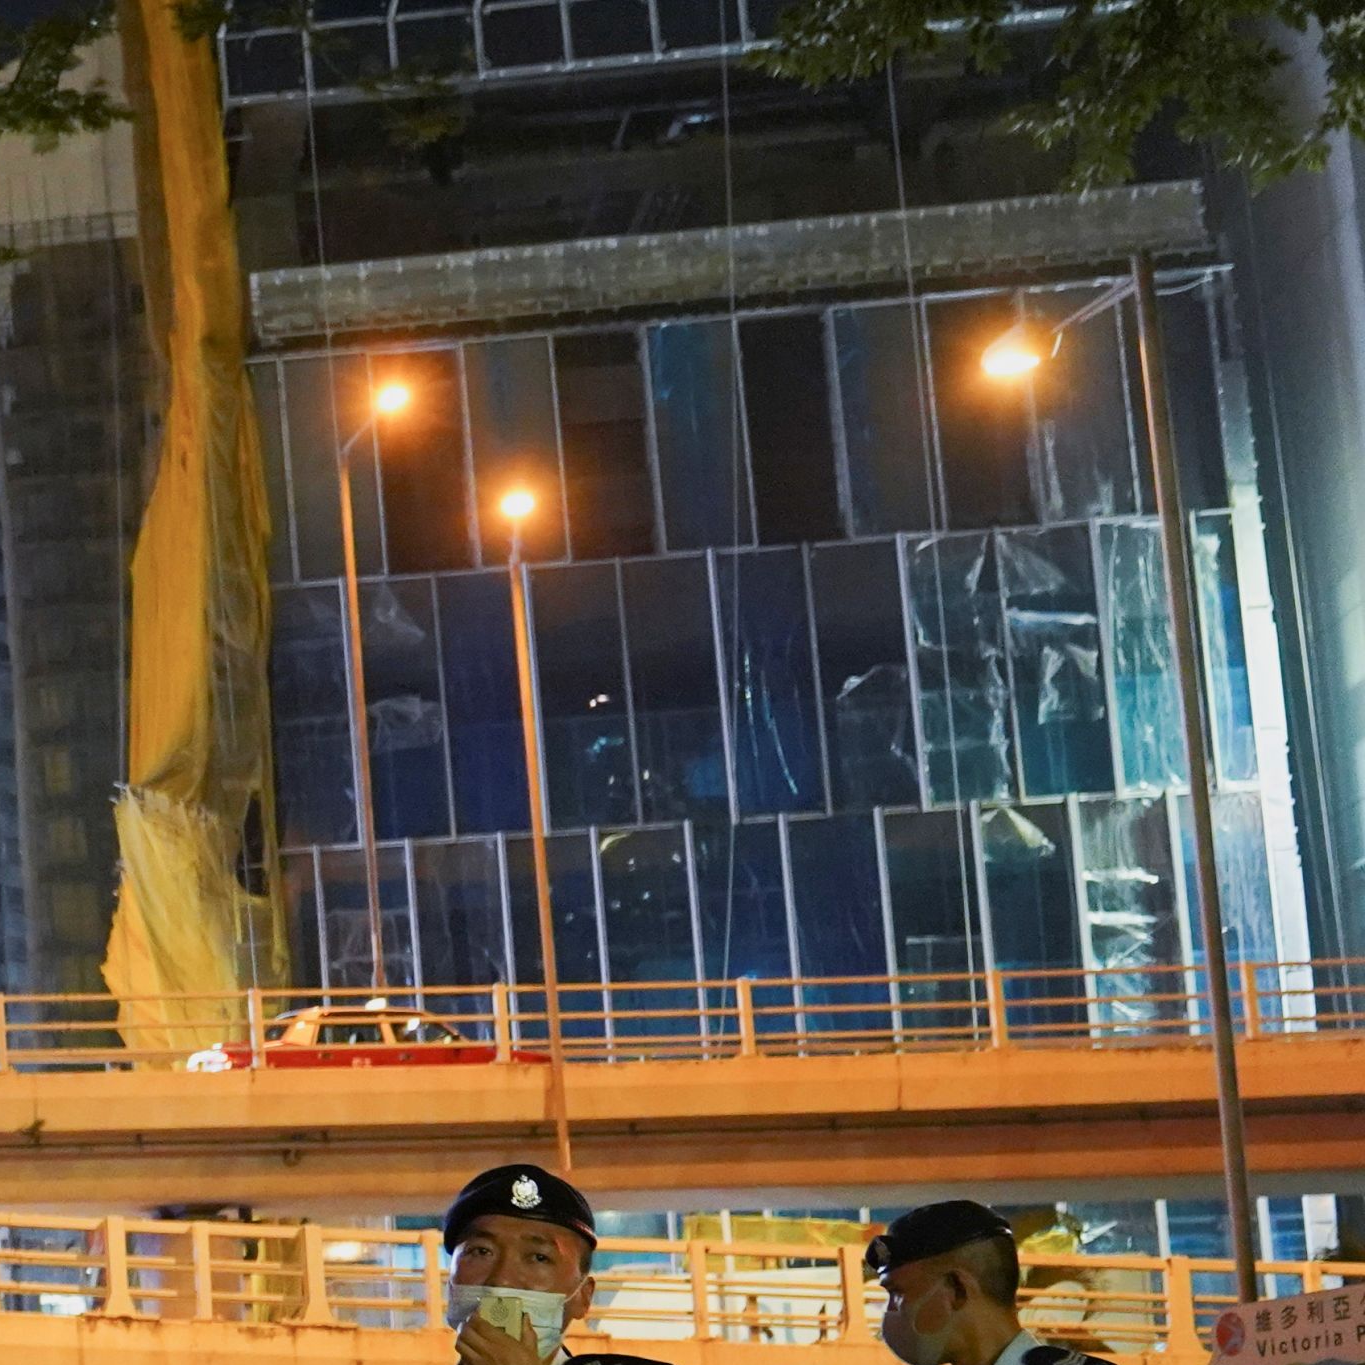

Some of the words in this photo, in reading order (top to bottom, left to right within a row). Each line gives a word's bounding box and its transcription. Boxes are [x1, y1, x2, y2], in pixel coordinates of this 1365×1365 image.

[1255, 1291, 1365, 1332] 維多利亞
[1255, 1329, 1344, 1357] Victoria
